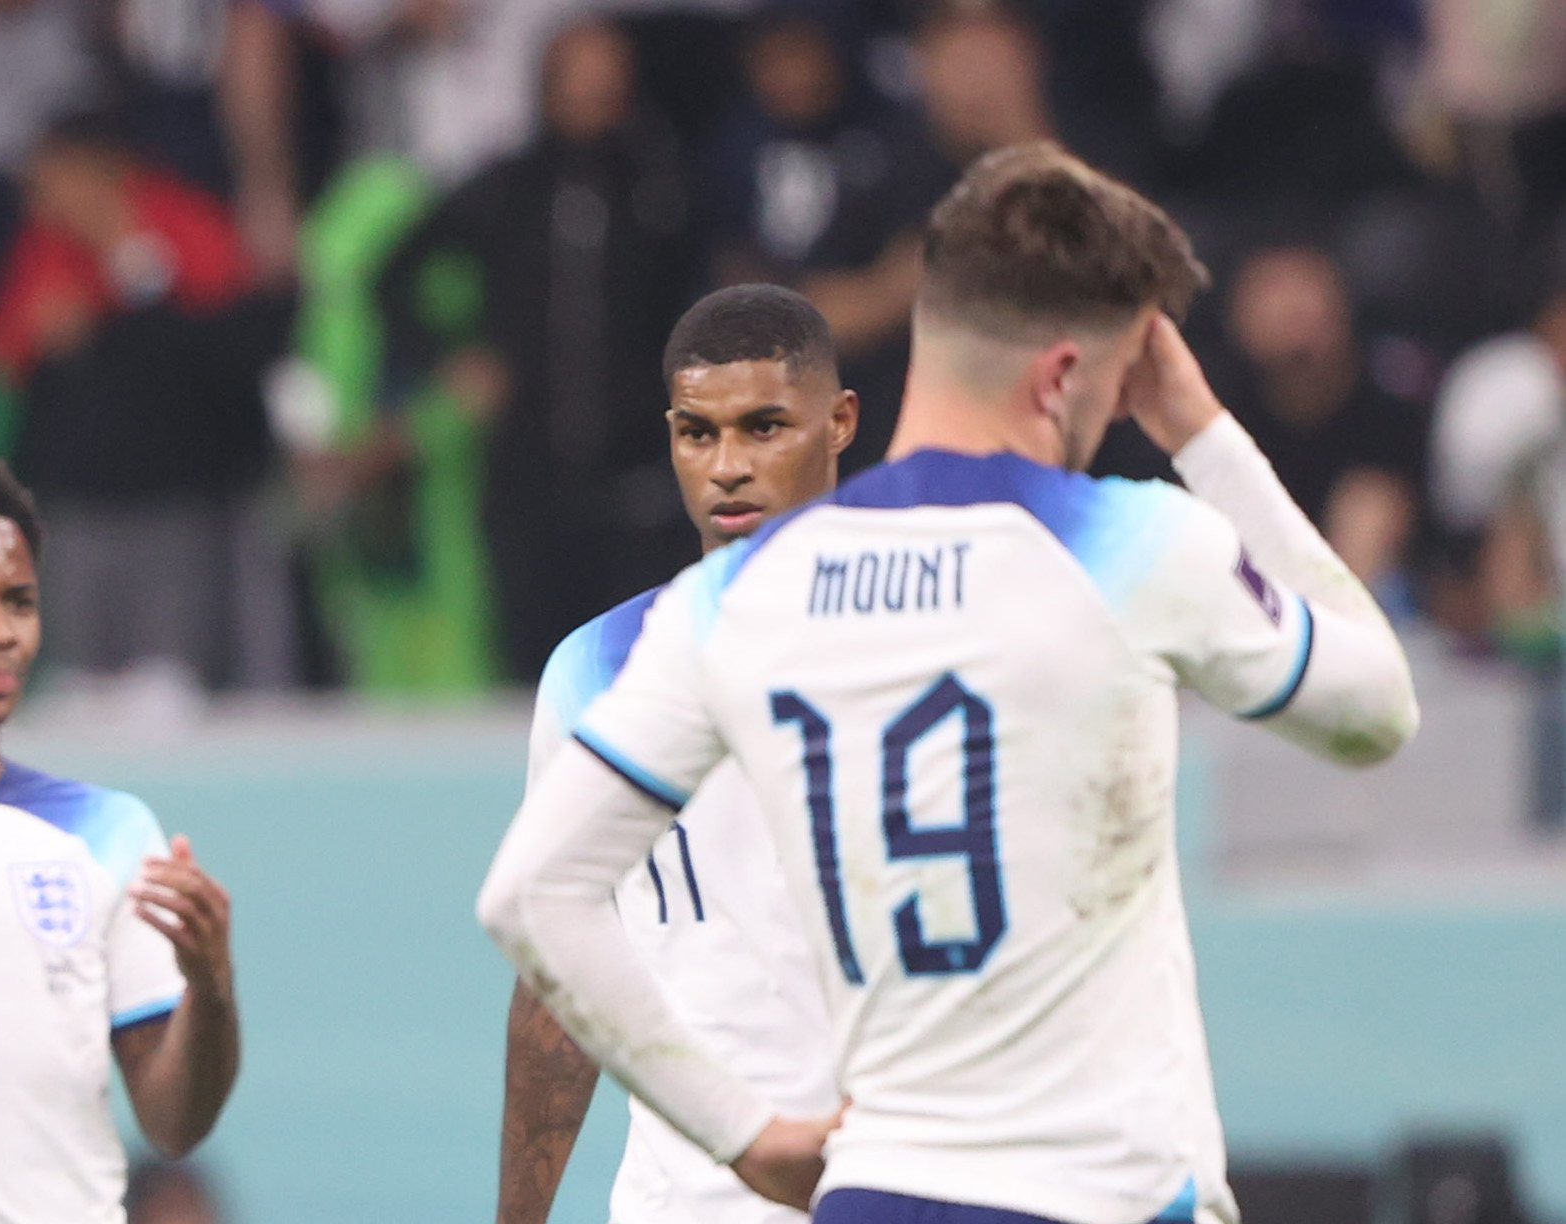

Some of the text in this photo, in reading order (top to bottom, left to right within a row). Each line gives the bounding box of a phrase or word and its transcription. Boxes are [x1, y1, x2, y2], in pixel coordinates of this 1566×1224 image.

[807, 541, 972, 618] MOUNT
[647, 820, 705, 924] 11
[768, 670, 1009, 986] 19
